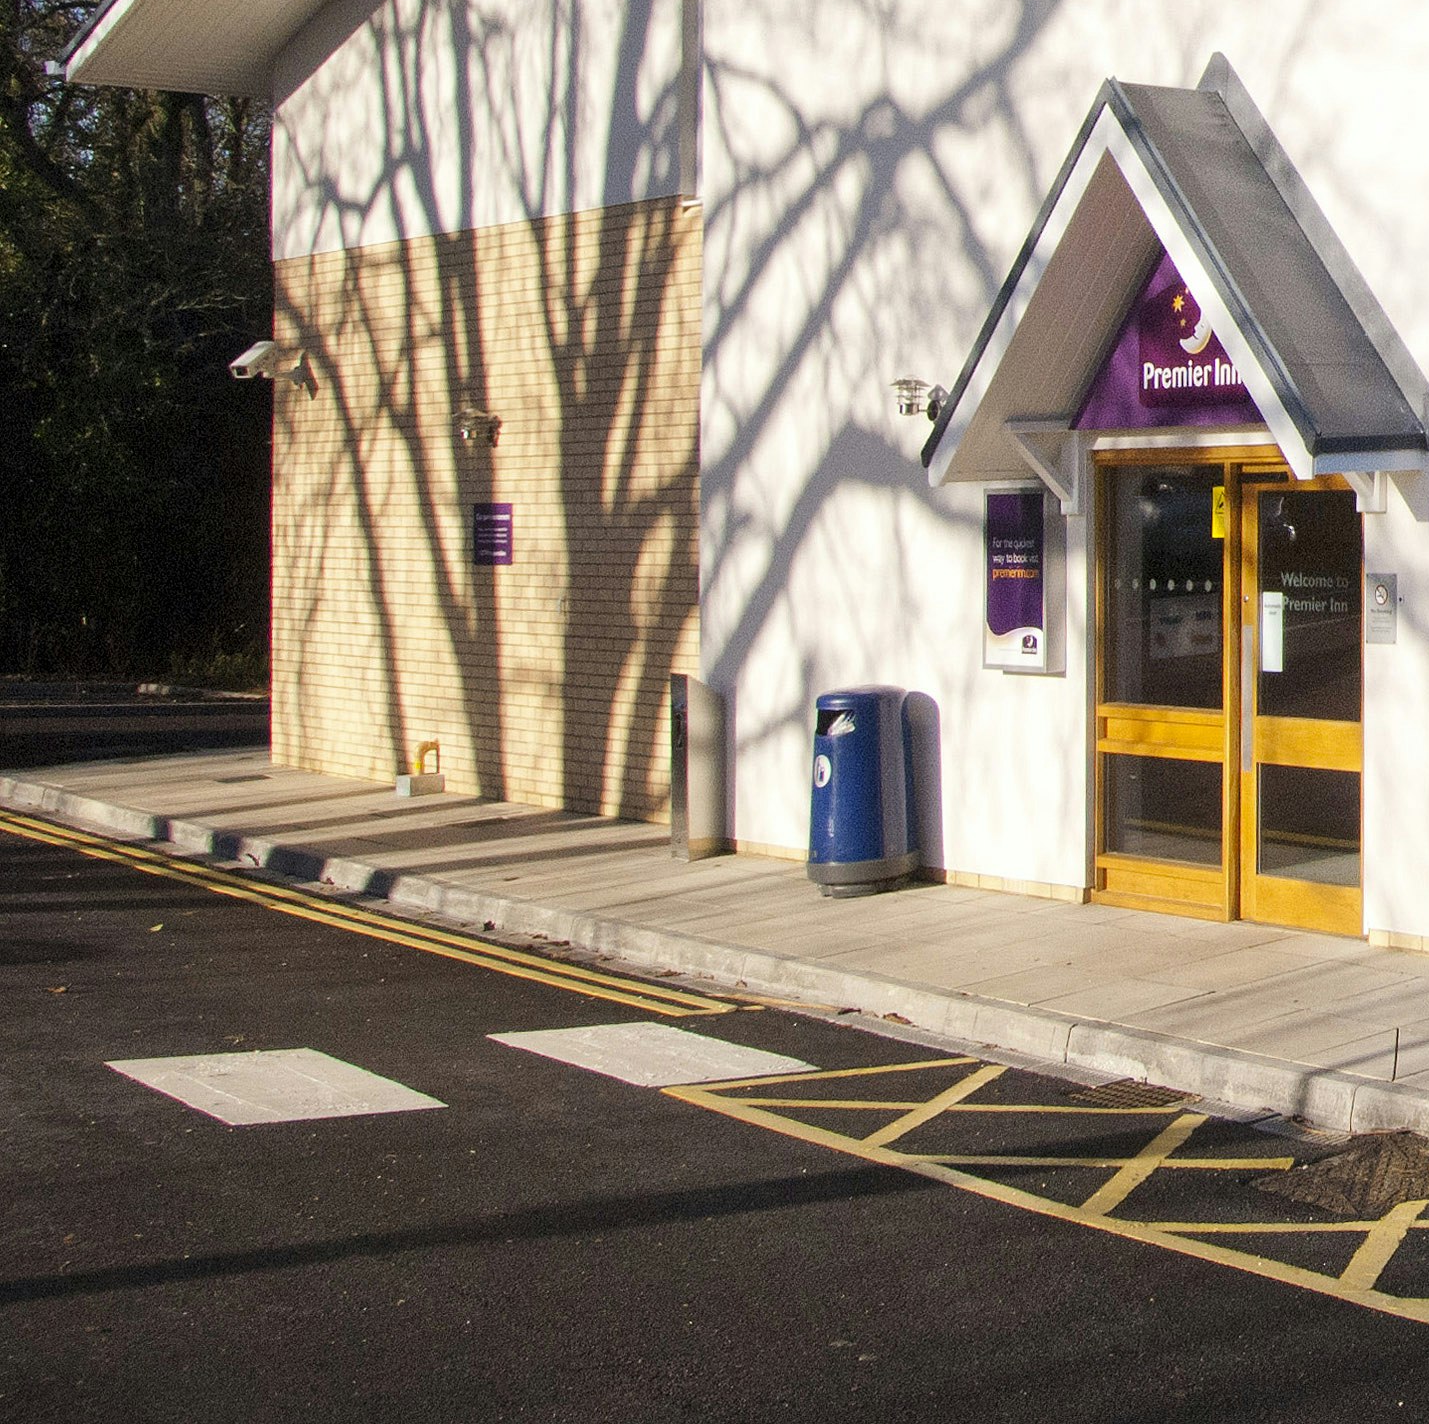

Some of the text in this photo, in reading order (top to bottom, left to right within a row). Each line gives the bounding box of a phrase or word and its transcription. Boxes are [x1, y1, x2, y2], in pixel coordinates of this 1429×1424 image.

[1143, 359, 1212, 390] Premier
[1281, 572, 1348, 588] Welcome to
[1283, 596, 1348, 612] Premier Inn
